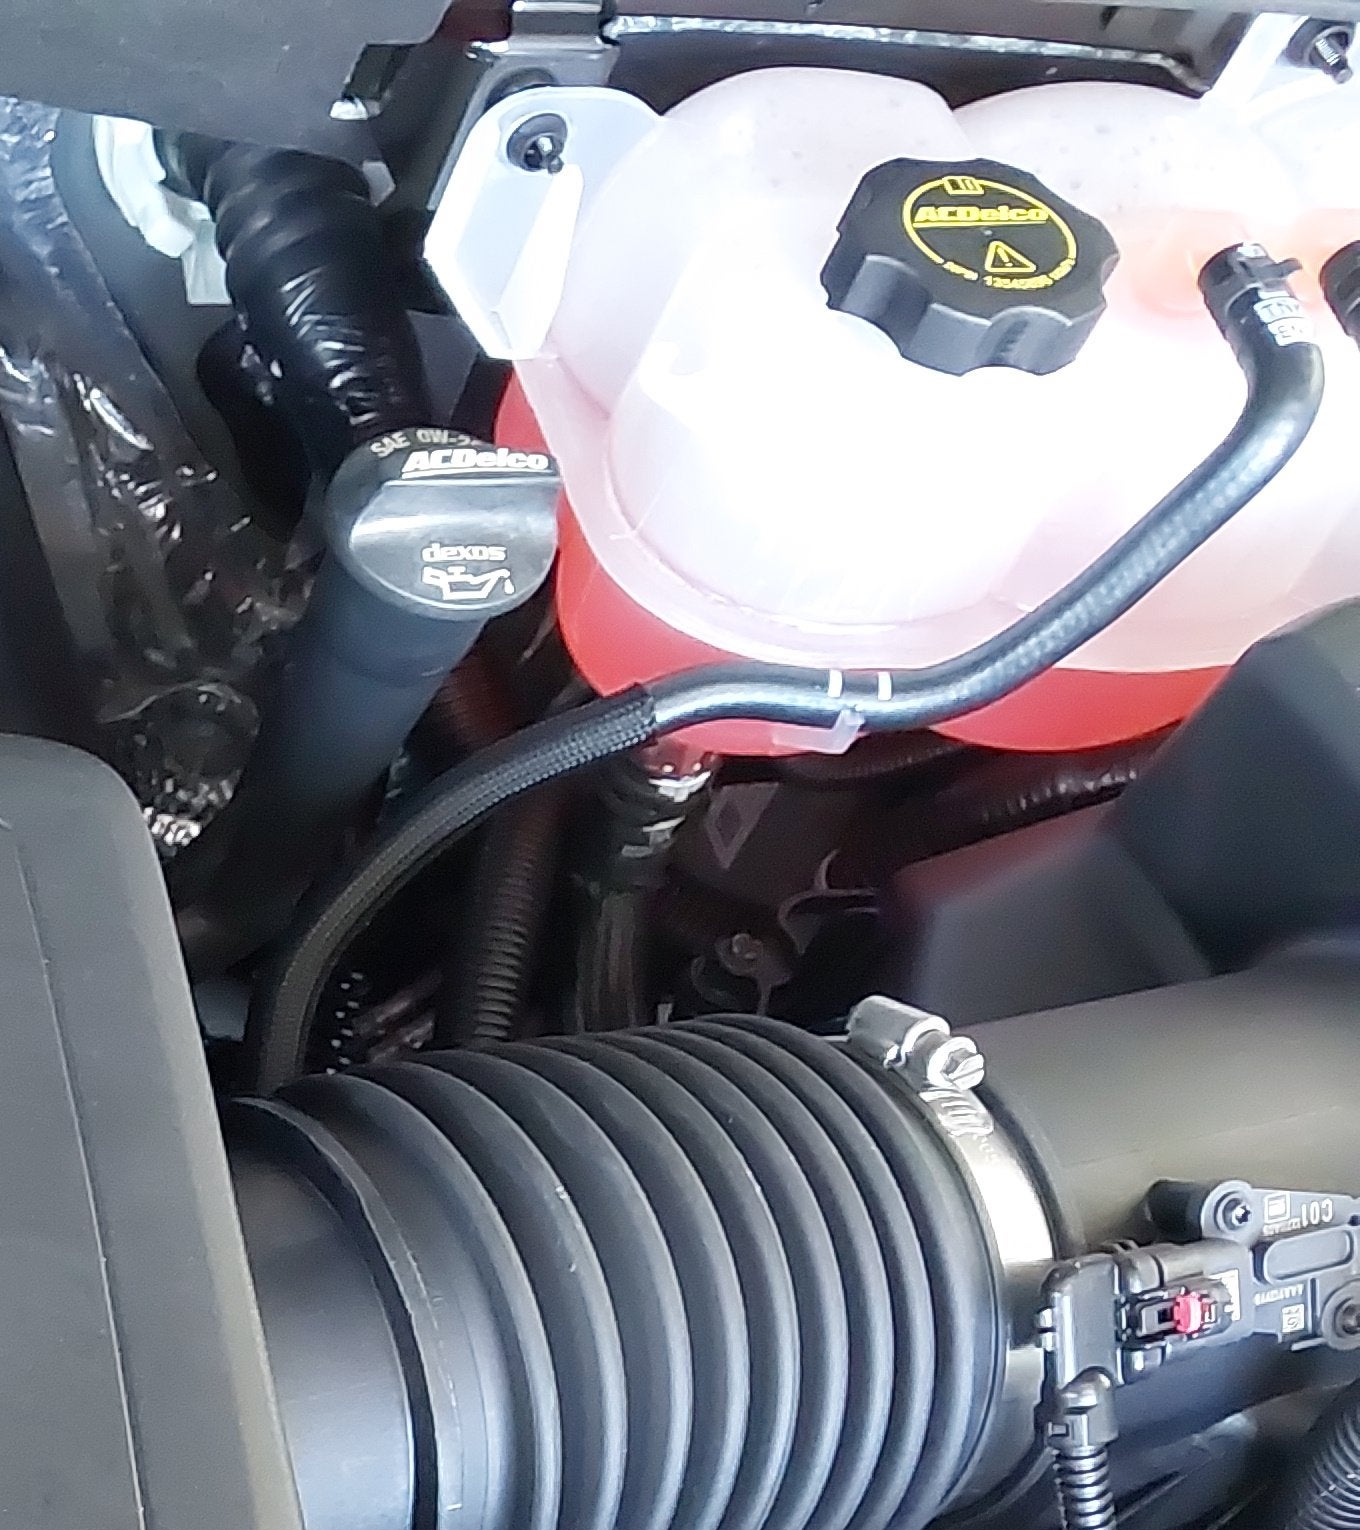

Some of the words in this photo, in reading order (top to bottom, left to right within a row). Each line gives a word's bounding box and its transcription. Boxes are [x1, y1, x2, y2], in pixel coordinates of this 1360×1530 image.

[914, 205, 1049, 222] ACDelco
[370, 432, 411, 458] SAE
[416, 429, 482, 446] 0W-2
[402, 448, 549, 472] ACDelco
[421, 542, 507, 562] dexos
